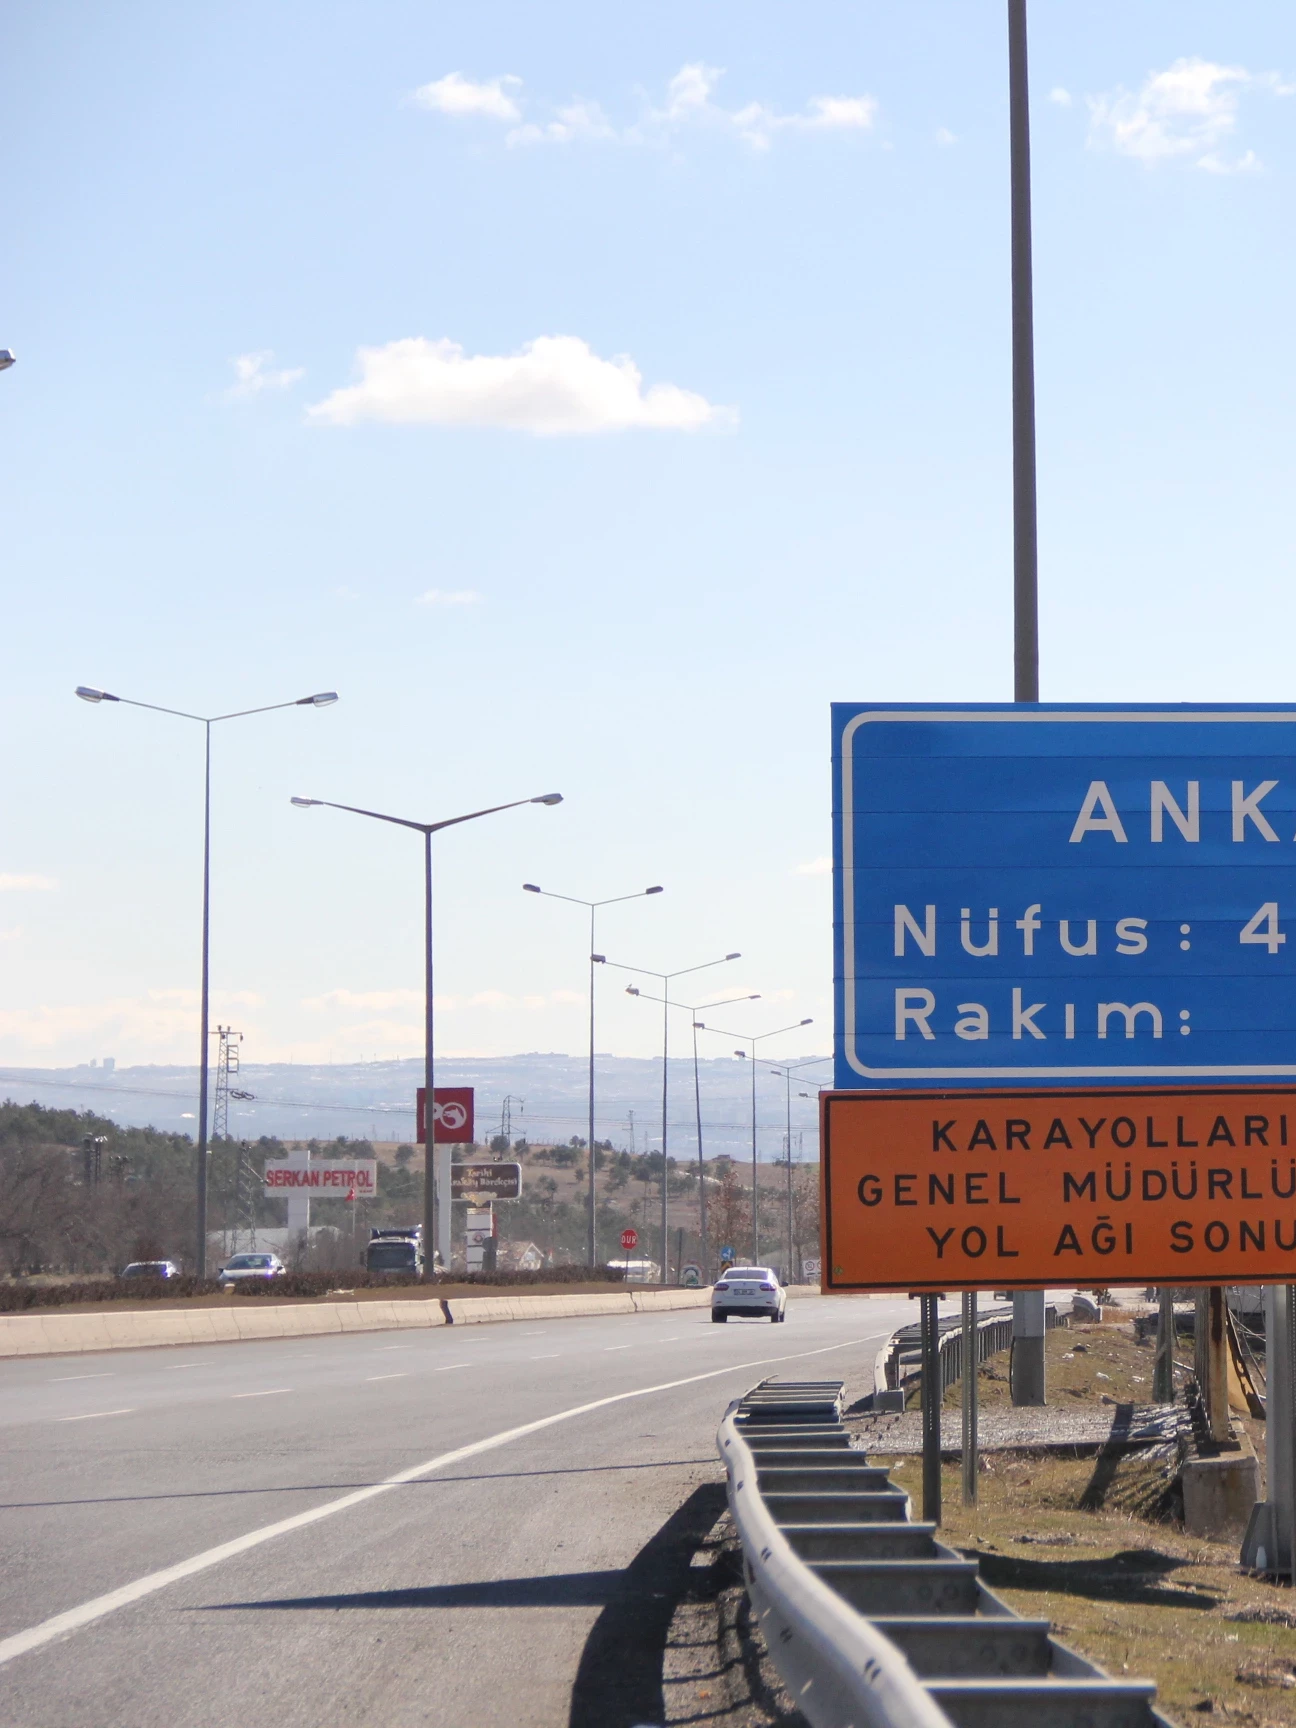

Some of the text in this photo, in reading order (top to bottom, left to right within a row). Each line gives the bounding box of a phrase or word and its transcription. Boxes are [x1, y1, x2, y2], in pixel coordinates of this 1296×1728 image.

[895, 987, 1191, 1041] Rakım:
[932, 1113, 1288, 1152] KARAYOLLARI
[266, 1170, 373, 1187] SERKAN PETROL
[857, 1171, 1021, 1207] GENEL
[622, 1235, 636, 1244] DUR
[926, 1224, 1020, 1260] YOL
[1053, 1215, 1133, 1257] AĞI
